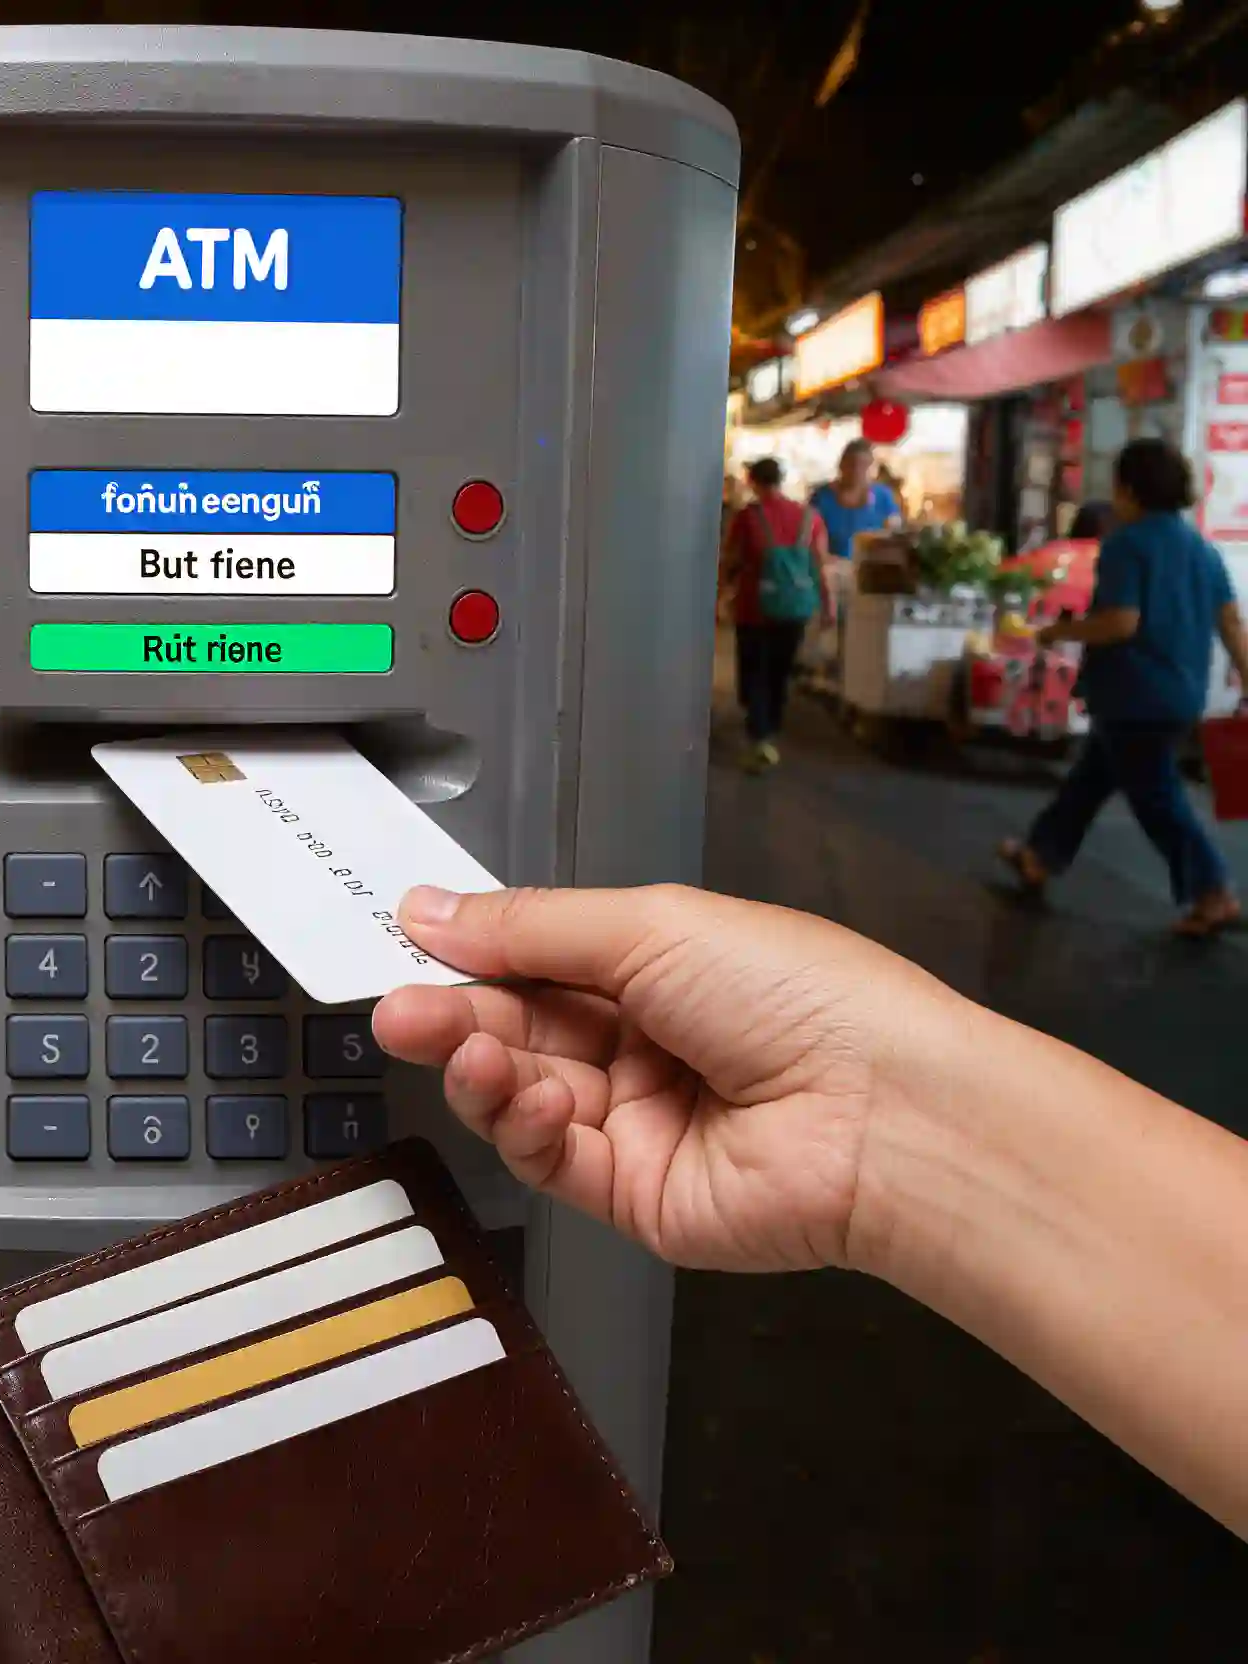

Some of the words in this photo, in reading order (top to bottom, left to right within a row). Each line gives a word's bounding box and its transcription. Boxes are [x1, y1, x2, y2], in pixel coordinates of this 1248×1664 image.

[138, 226, 289, 291] ATM
[140, 549, 199, 579] But
[209, 547, 296, 580] fiene
[38, 948, 58, 978] 4
[140, 953, 158, 981] 2
[141, 1034, 159, 1063] 2
[240, 1034, 258, 1064] 3
